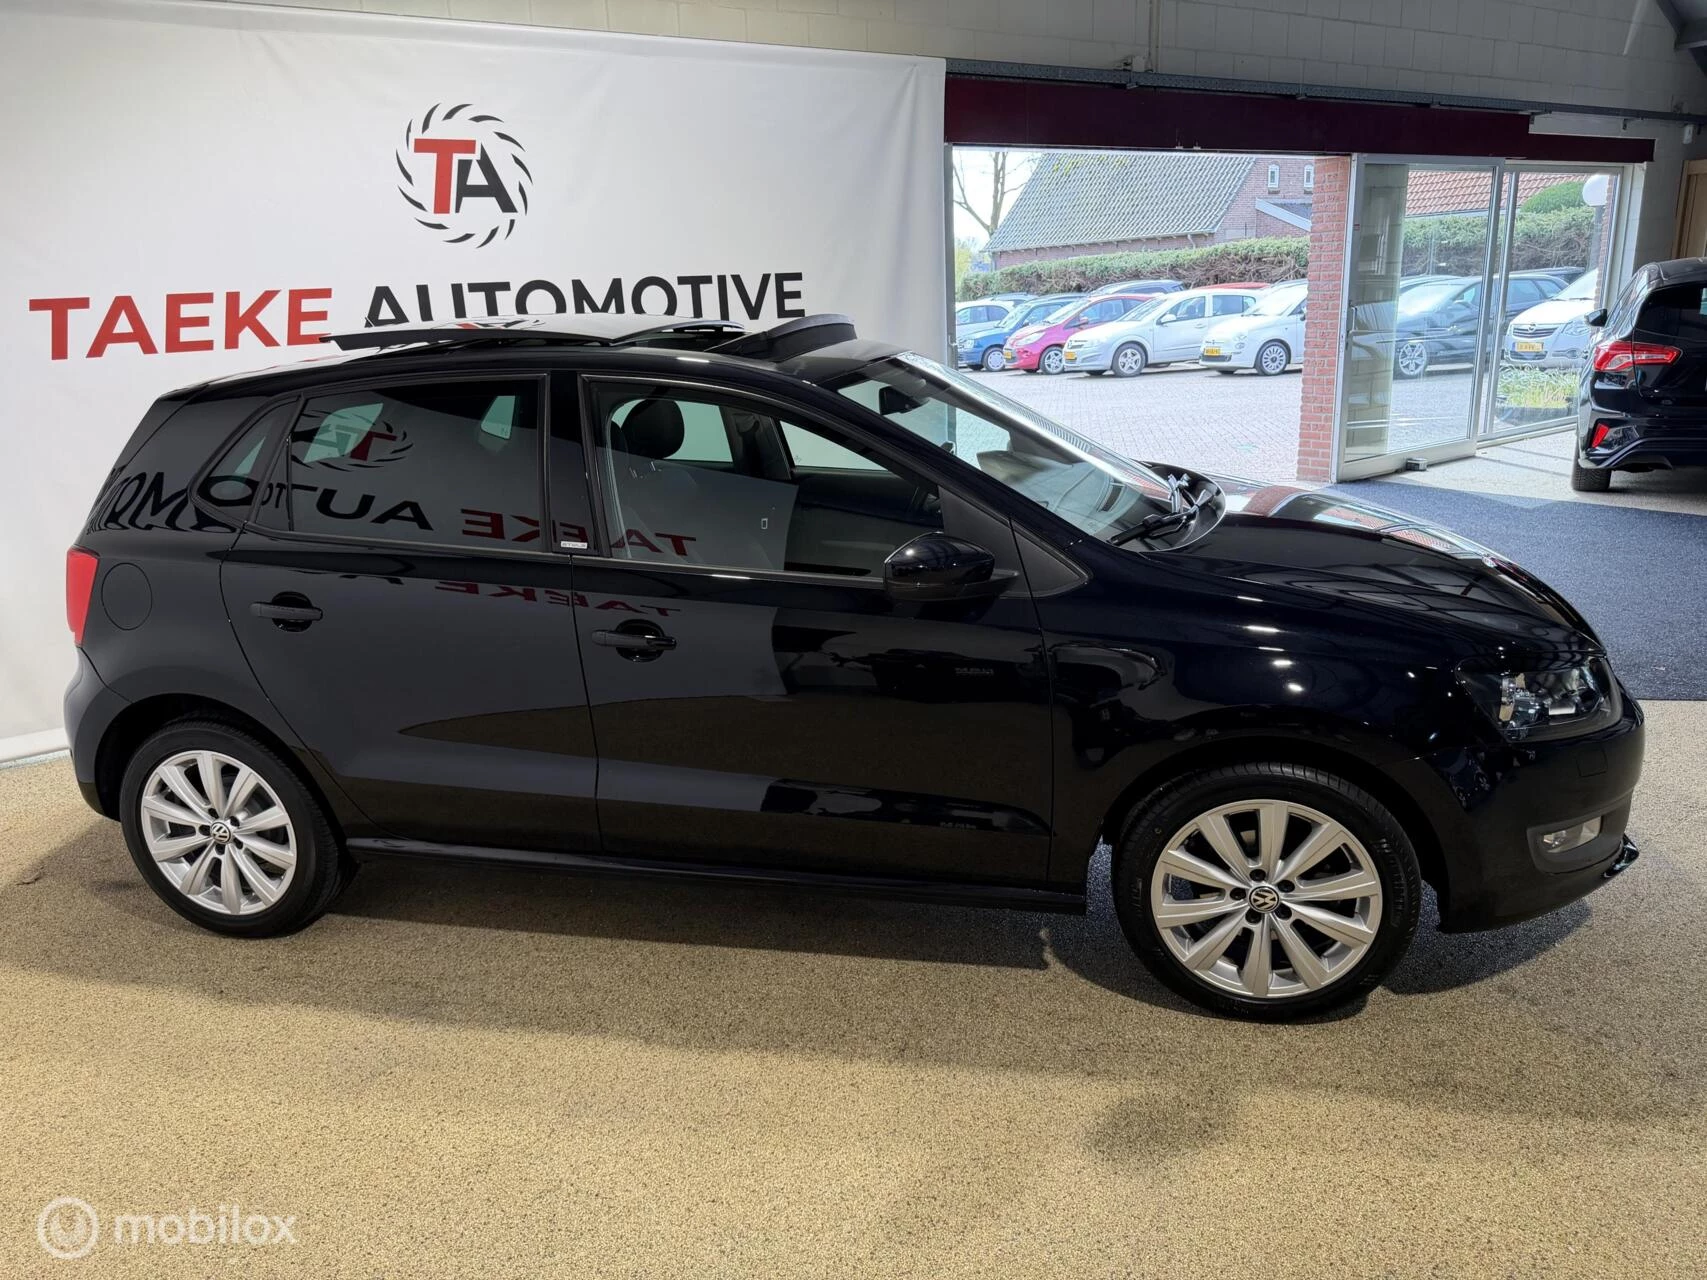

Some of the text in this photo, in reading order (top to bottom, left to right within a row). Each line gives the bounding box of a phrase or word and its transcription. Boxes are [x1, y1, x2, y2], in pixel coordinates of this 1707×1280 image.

[414, 138, 518, 214] TA
[29, 272, 806, 360] TAEKE AUTOMOTIVE
